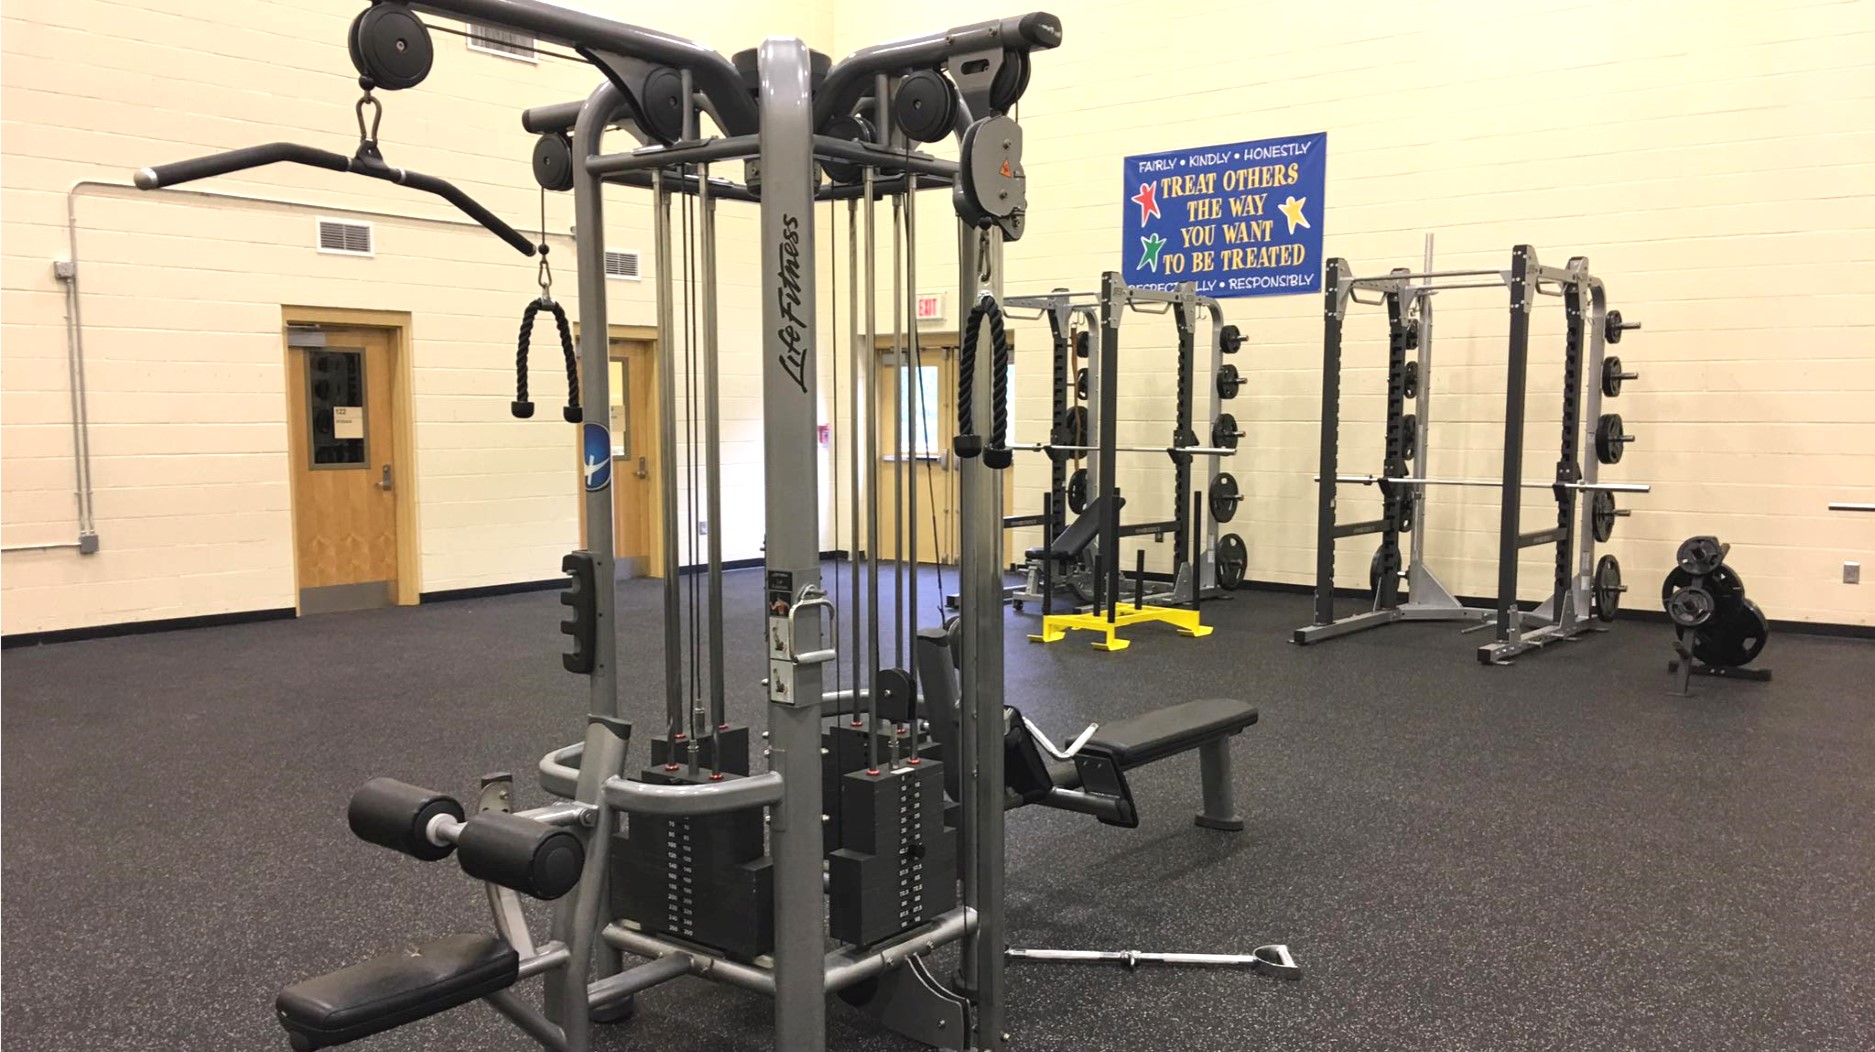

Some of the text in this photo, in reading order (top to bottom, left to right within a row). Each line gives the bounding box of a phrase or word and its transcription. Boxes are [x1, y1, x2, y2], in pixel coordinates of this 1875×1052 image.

[1139, 141, 1312, 173] FAIRLY KINDLY HONESTLY
[1161, 163, 1299, 199] TREAT OTHERS
[1187, 193, 1268, 222] THE WAY
[1180, 220, 1274, 248] YOU WANT
[1163, 243, 1306, 275] TO BE TREATED
[1230, 274, 1315, 290] RESPONSIBLY
[778, 213, 807, 394] Life Fitness
[918, 298, 937, 316] EXIT
